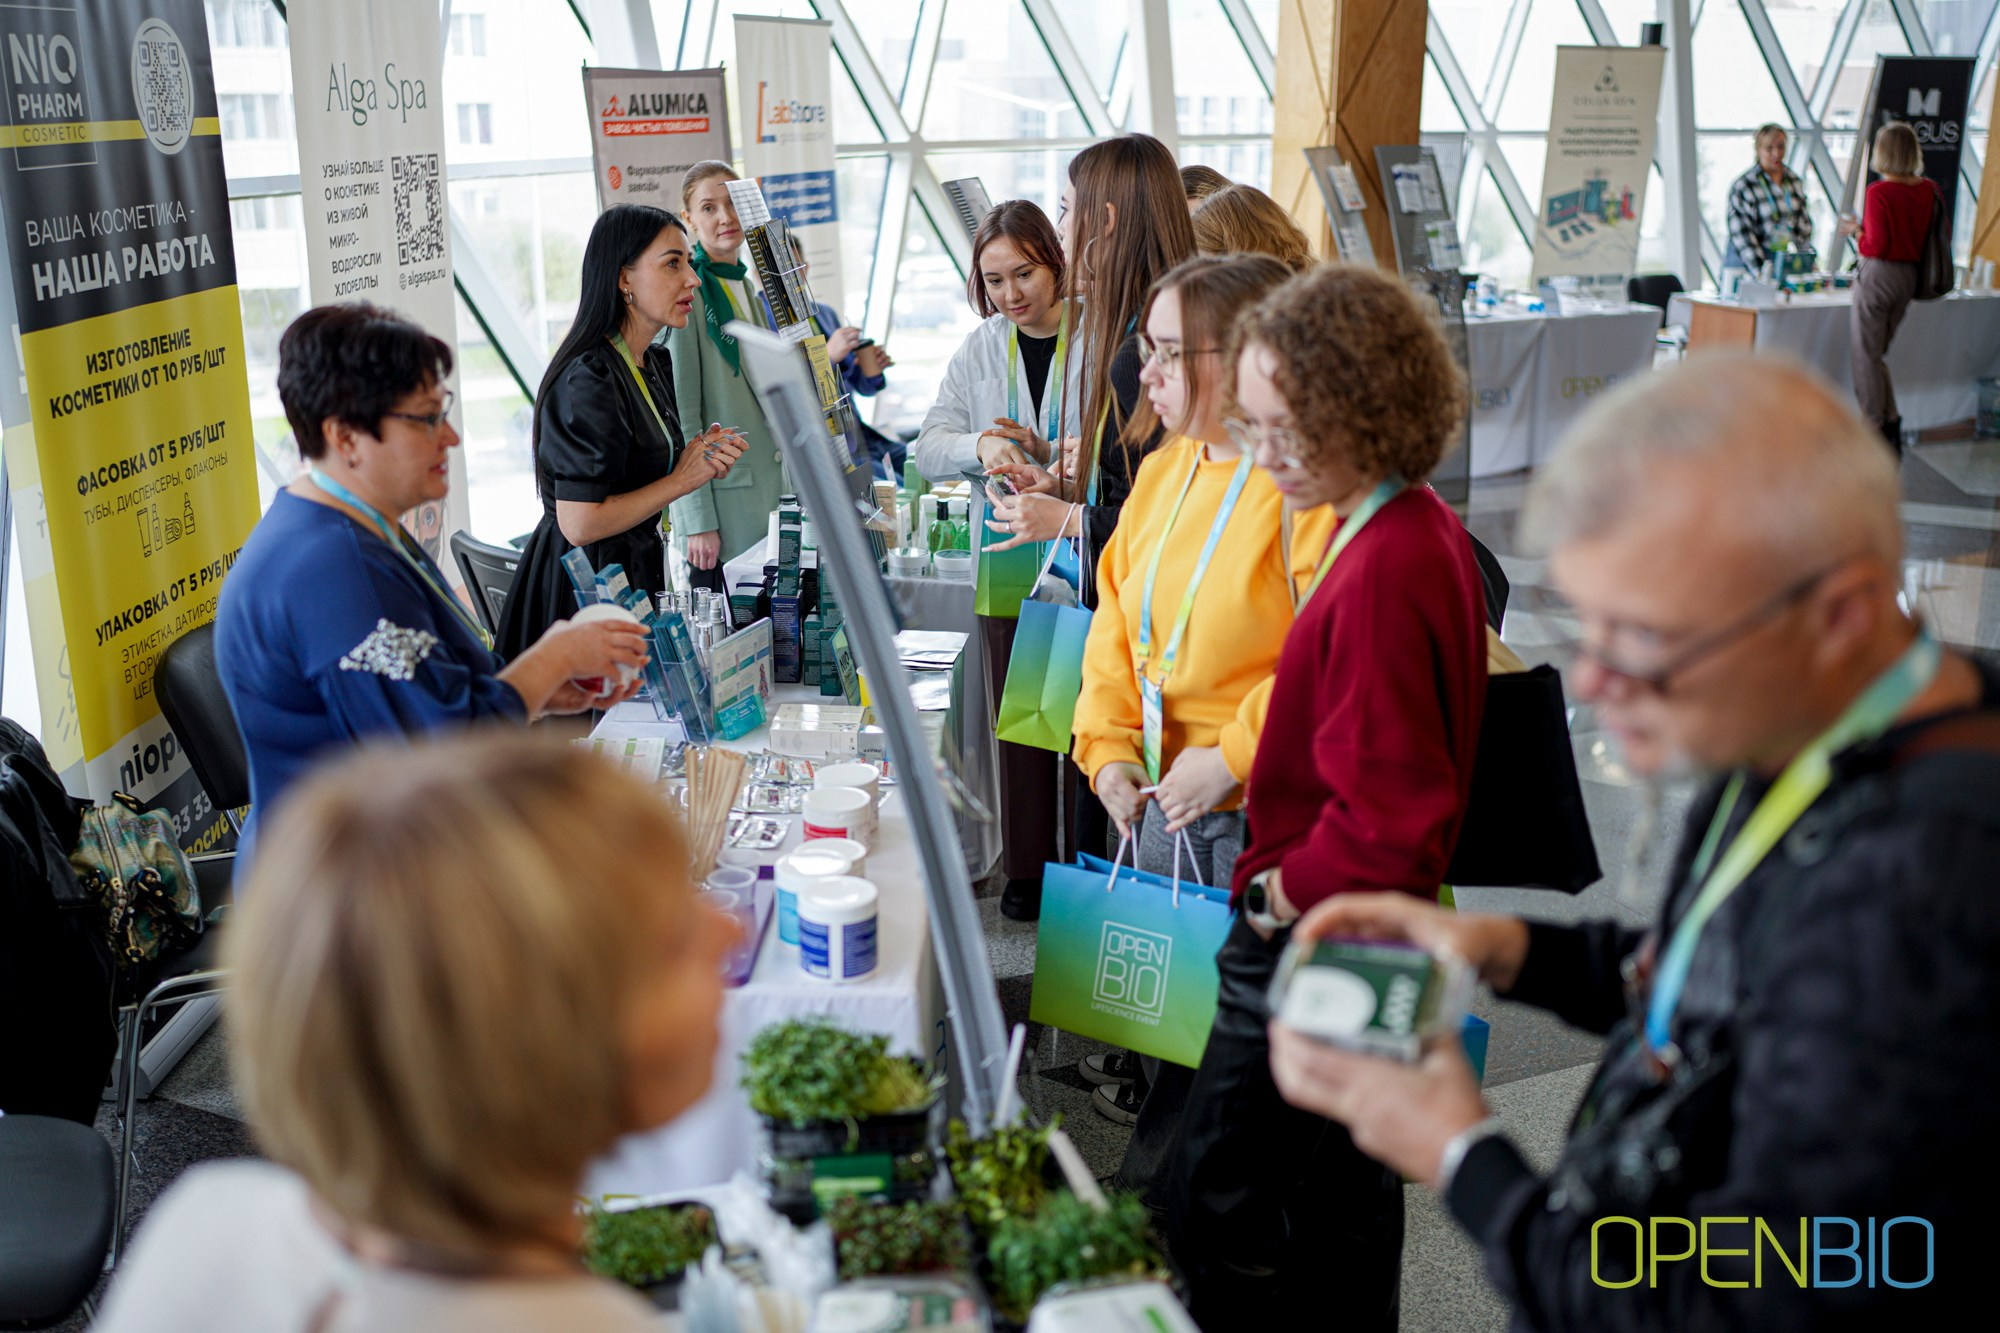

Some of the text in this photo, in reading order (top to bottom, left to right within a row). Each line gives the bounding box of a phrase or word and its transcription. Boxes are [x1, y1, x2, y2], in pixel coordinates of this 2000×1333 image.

[17, 92, 84, 119] PHARM
[326, 62, 427, 125] Alga Spa
[627, 92, 709, 117] ALUMICA
[23, 125, 86, 143] COSMETIC
[1912, 120, 1960, 144] GUS
[322, 159, 385, 178] УЗНАЙ БОЛЬШЕ
[333, 182, 380, 199] КОСМЕТИКЕ
[26, 214, 86, 247] ВАША
[89, 200, 187, 237] КОСМЕТИКА
[326, 203, 369, 224] ИЗ ЖИВОЙ
[329, 235, 360, 249] МИКРО-
[32, 233, 216, 302] НАША РАБОТА
[332, 252, 382, 273] ВОДОРОСЛИ
[407, 267, 446, 288] algaspa.ru
[335, 275, 379, 297] ХЛОРЕЛЛЫ
[86, 328, 192, 375] ИЗГОТОВЛЕНИЕ
[49, 346, 226, 419] КОСМЕТИКИ ОТ 10 РУБ/ШТ
[77, 420, 226, 496] ФАСОВКА ОТ 5 РУБ/ШТ
[84, 451, 229, 526] ТУБЫ, ДИСПЕНСЕРЫ, ФЛАКОНЫ
[95, 590, 169, 647] УПАКОВКА
[170, 578, 186, 602] ОТ
[189, 573, 198, 592] 5
[121, 623, 175, 664] ЭТИКЕТКА,
[175, 593, 221, 632] ДАТИРОВ
[120, 731, 182, 793] niop
[1106, 930, 1166, 967] OPEN
[1099, 955, 1162, 1009] BIO
[1135, 1013, 1160, 1027] EVENT
